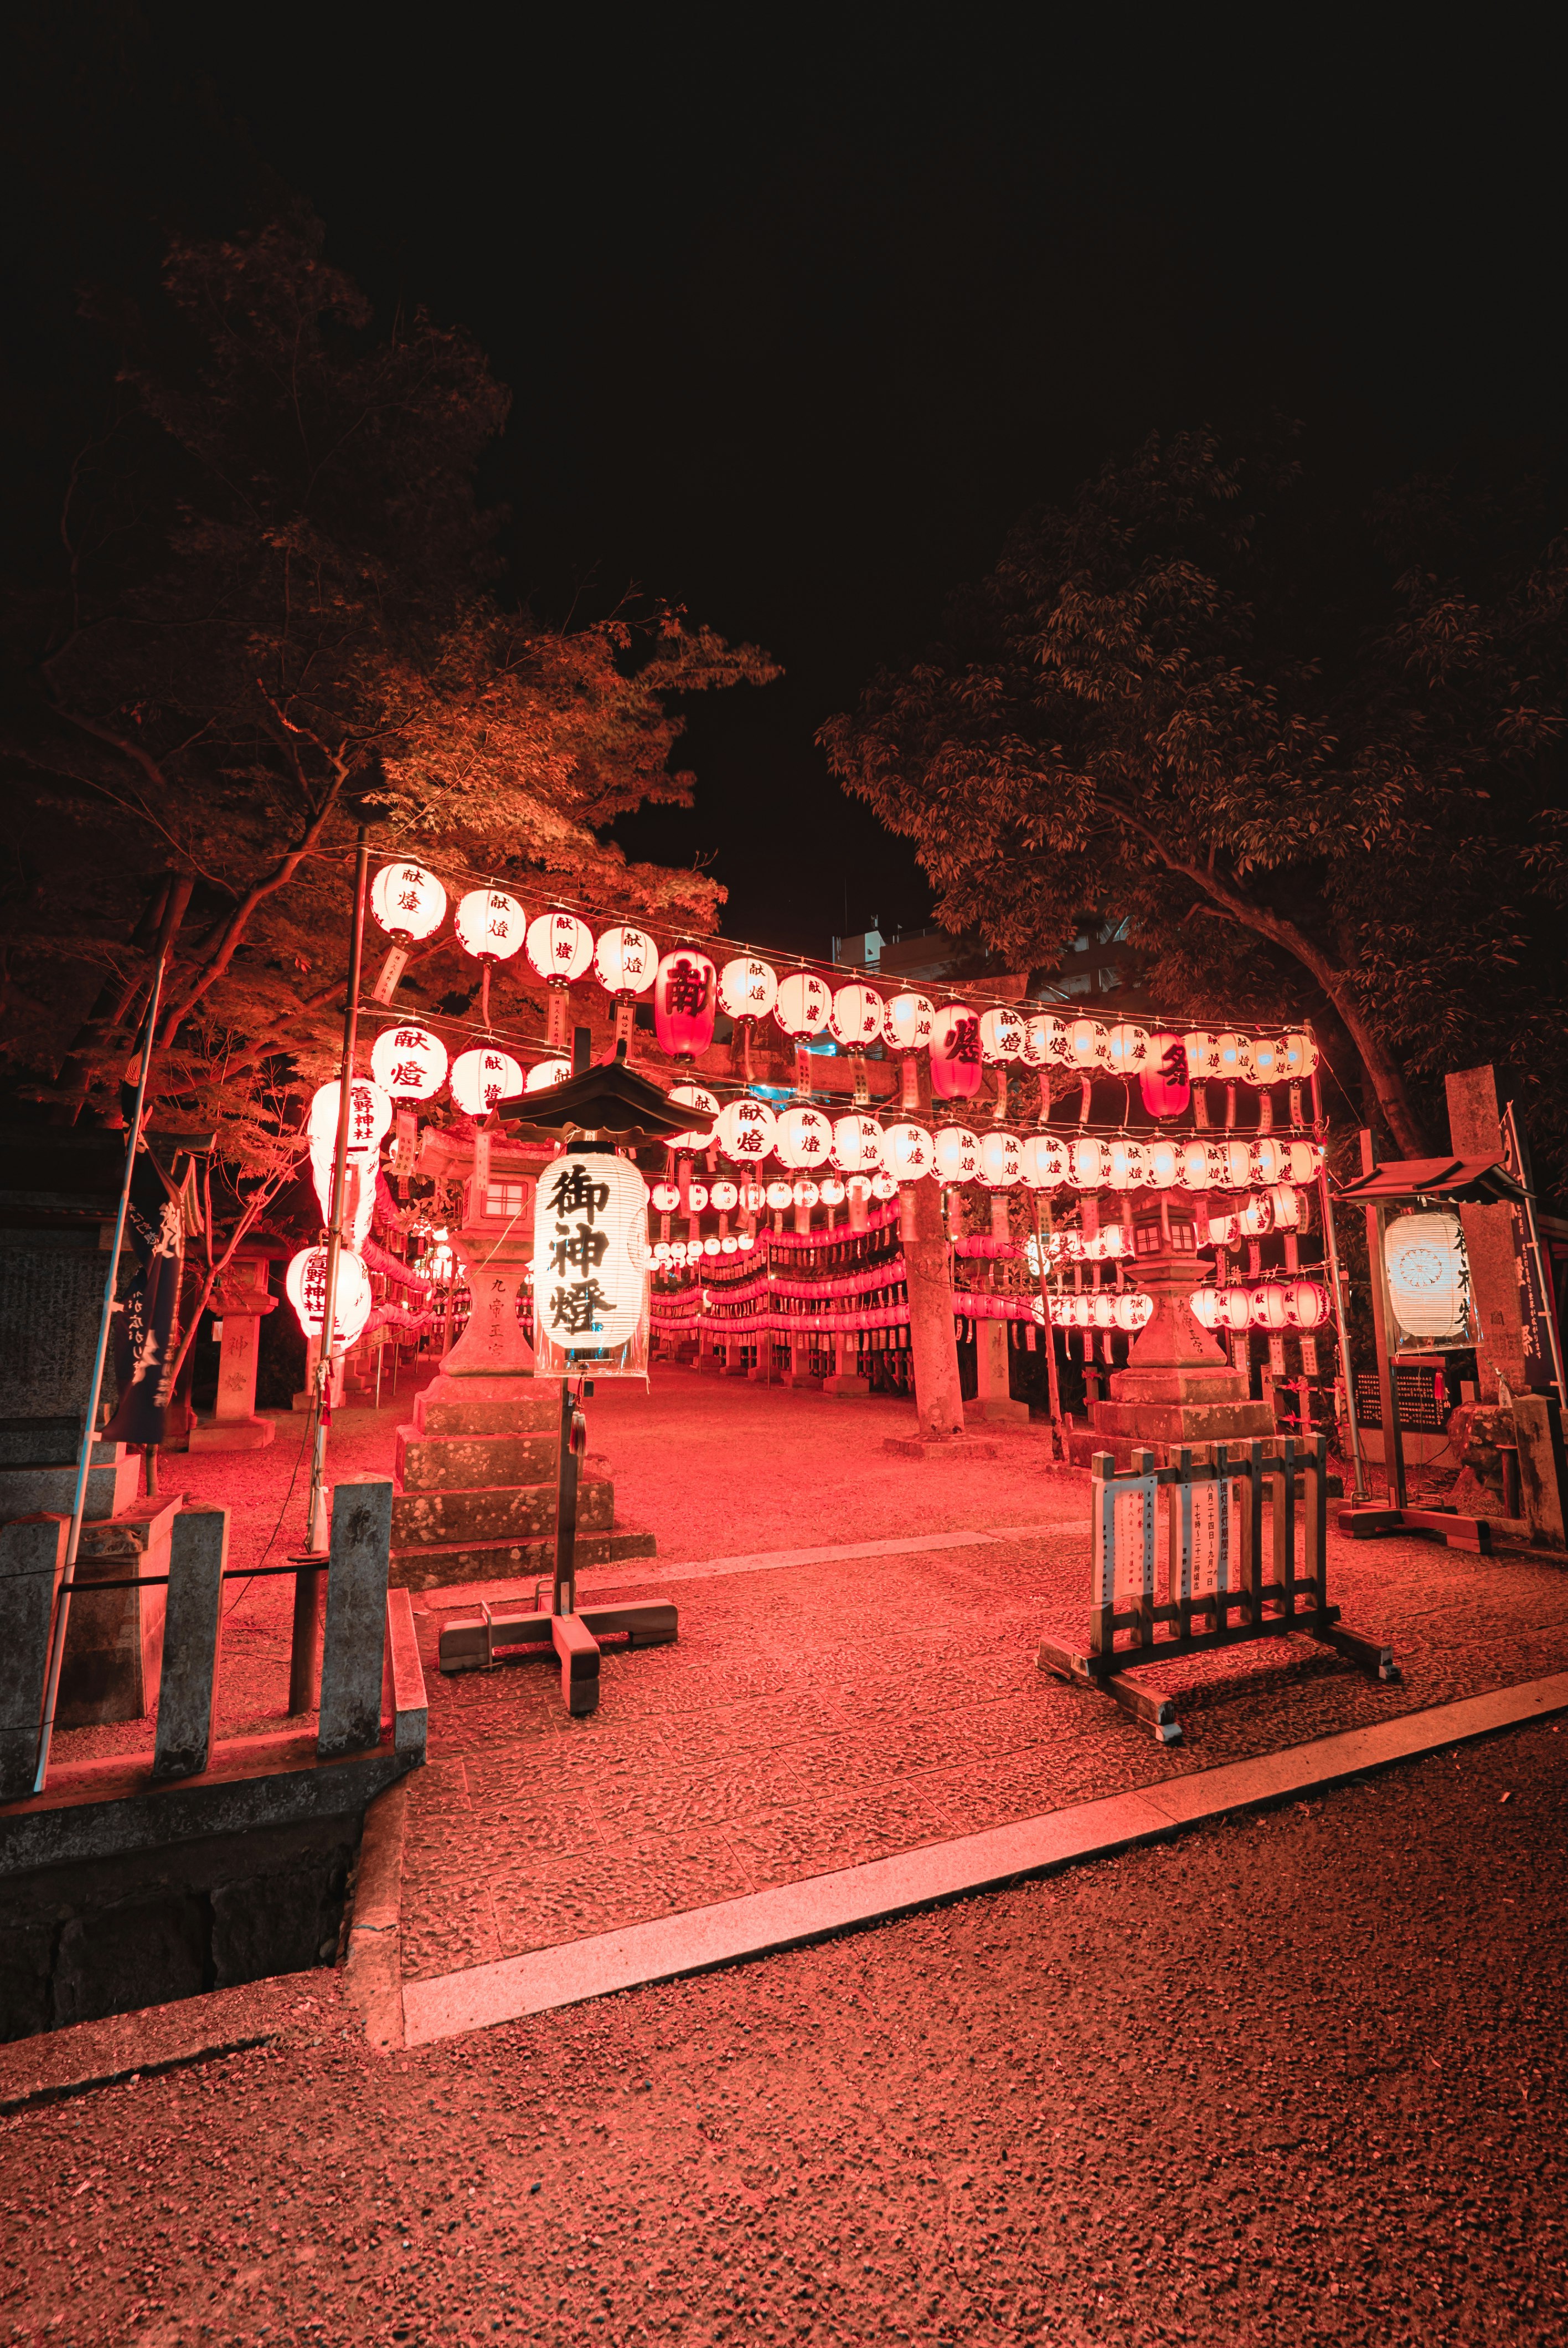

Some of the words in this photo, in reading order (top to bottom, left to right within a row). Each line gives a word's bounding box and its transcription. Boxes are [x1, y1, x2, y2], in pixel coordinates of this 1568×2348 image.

[397, 869, 425, 913] 献燈
[487, 895, 510, 938] 献燈
[556, 916, 574, 959] 献燈
[623, 933, 643, 974] 献燈
[749, 962, 766, 1001] 献燈
[806, 980, 822, 1021] 献燈
[863, 992, 878, 1032] 献燈
[916, 1000, 932, 1035] 献燈
[999, 1011, 1023, 1053] 献燈
[390, 1030, 431, 1087] 献燈
[1131, 1028, 1148, 1059] 献燈
[1237, 1037, 1250, 1067] 献燈
[350, 1086, 375, 1140] 萱野神社
[737, 1103, 767, 1152] 献燈
[801, 1113, 822, 1152] 献燈
[861, 1122, 878, 1159] 献燈
[906, 1129, 925, 1164] 献燈
[959, 1135, 976, 1171] 献燈
[1003, 1140, 1019, 1175] 献燈
[1045, 1140, 1062, 1173] 献燈
[1127, 1147, 1143, 1179] 献燈
[545, 1163, 617, 1336] 御神燈
[1220, 1482, 1229, 1561] 提灯点灯期間は
